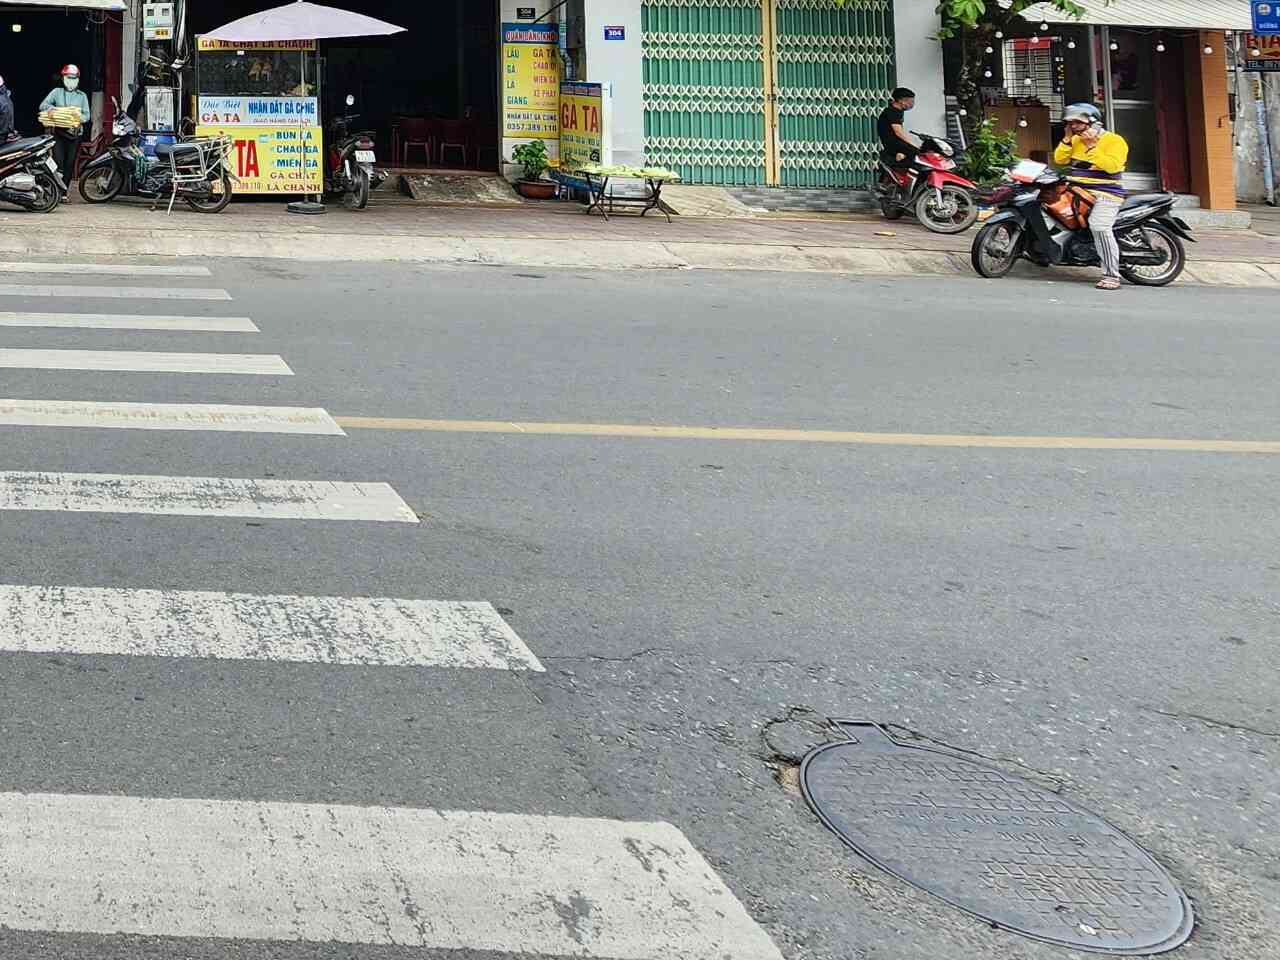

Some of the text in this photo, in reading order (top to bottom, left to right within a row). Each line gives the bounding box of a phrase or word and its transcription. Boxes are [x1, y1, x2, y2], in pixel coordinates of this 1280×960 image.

[223, 113, 241, 123] TA
[582, 105, 599, 133] TA
[234, 140, 260, 177] TA
